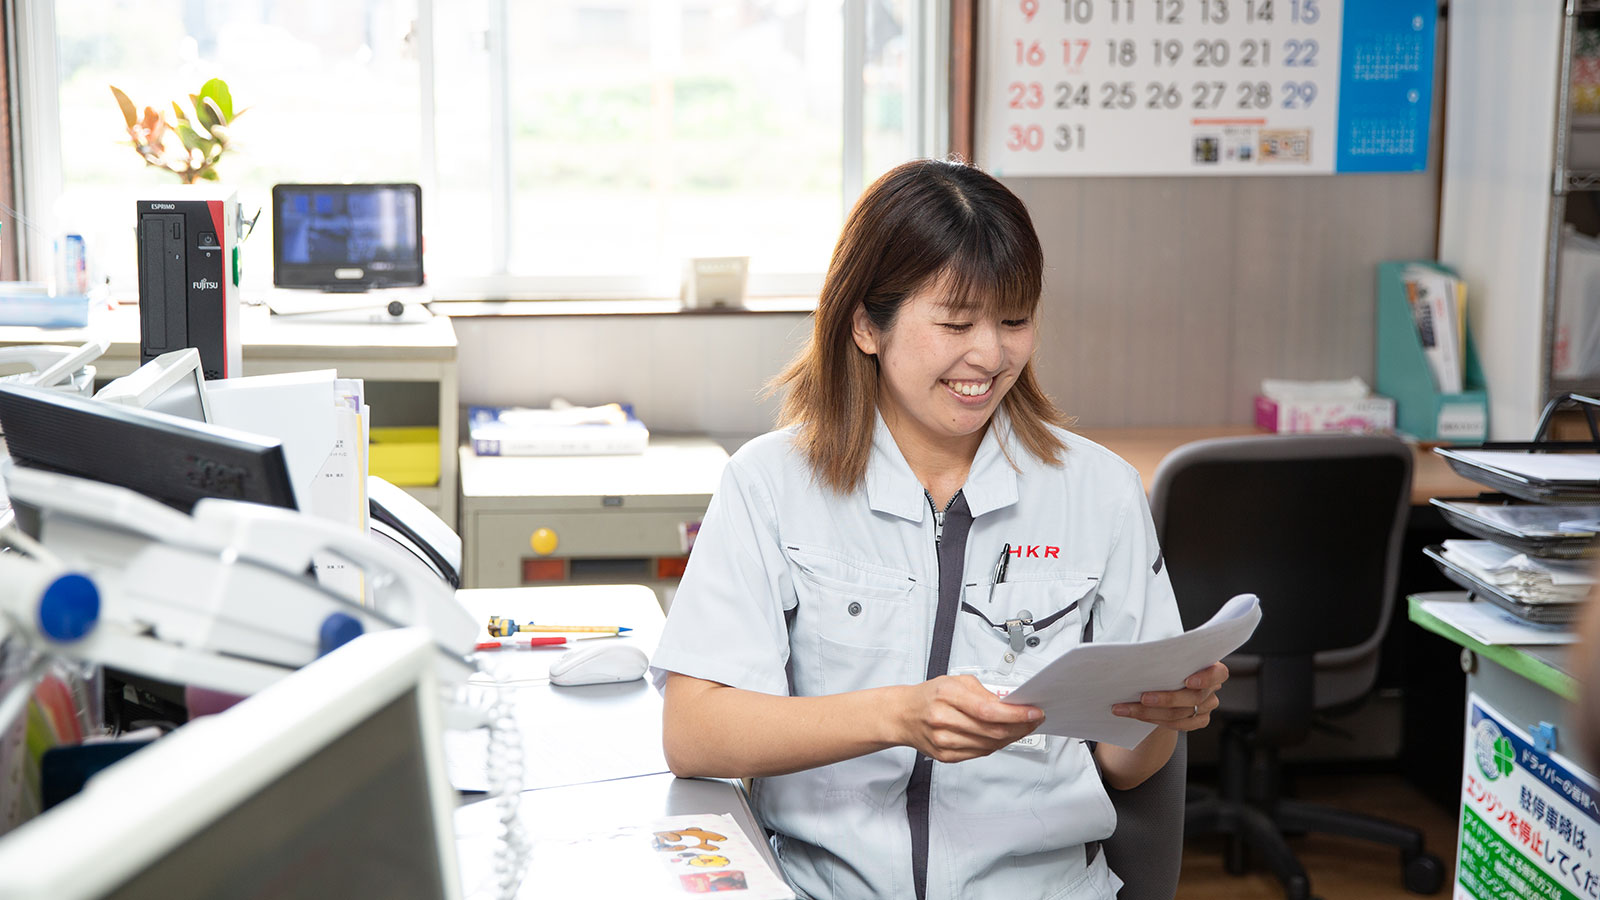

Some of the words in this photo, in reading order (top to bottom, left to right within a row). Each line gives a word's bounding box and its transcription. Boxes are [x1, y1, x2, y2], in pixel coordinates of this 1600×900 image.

[1020, 0, 1039, 23] 9
[1062, 0, 1093, 24] 10
[1110, 0, 1136, 23] 11
[1155, 0, 1184, 24] 12
[1200, 0, 1230, 24] 13
[1245, 0, 1274, 24] 14
[1291, 0, 1320, 24] 15
[1014, 38, 1046, 67] 16
[1061, 38, 1091, 67] 17
[1106, 38, 1137, 67] 18
[1152, 38, 1184, 67] 19
[1193, 38, 1230, 67] 20
[1239, 38, 1271, 67] 21
[1283, 38, 1320, 67] 22
[1008, 81, 1045, 109] 23
[1054, 81, 1090, 109] 24
[1100, 81, 1137, 109] 25
[1146, 81, 1183, 109] 26
[1192, 81, 1227, 109] 27
[1236, 81, 1272, 109] 28
[1281, 81, 1318, 109] 29
[1006, 124, 1045, 152] 30
[1054, 124, 1086, 152] 31
[193, 278, 218, 290] FUJITSU
[1009, 545, 1060, 559] HKR
